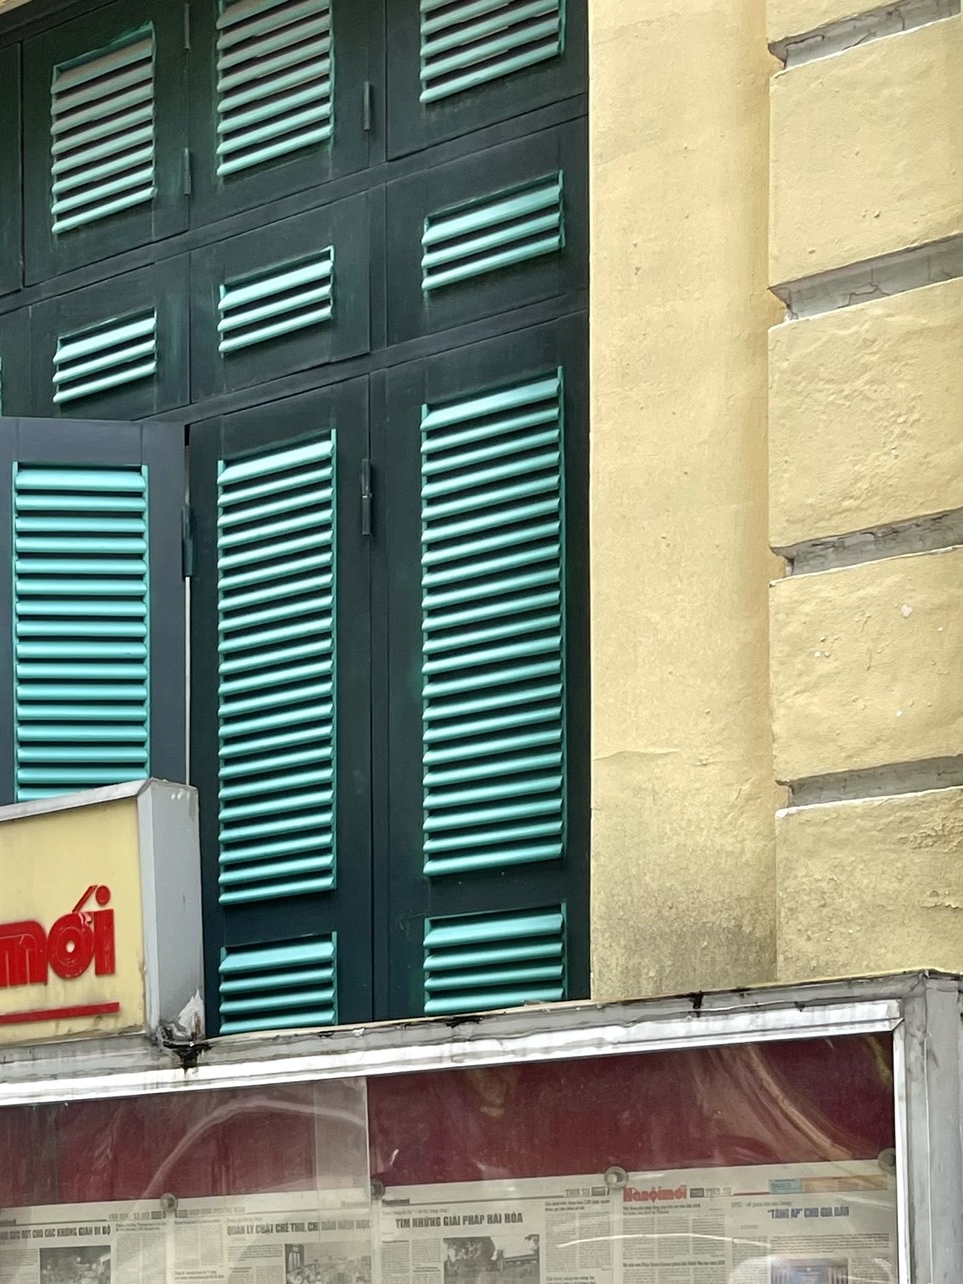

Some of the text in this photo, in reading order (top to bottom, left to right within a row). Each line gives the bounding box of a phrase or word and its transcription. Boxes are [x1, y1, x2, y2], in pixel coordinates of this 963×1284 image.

[396, 1217, 410, 1228] TÌM
[412, 1215, 441, 1228] NHỮNG
[443, 1213, 460, 1226] GIẢI
[462, 1212, 485, 1225] PHÁP
